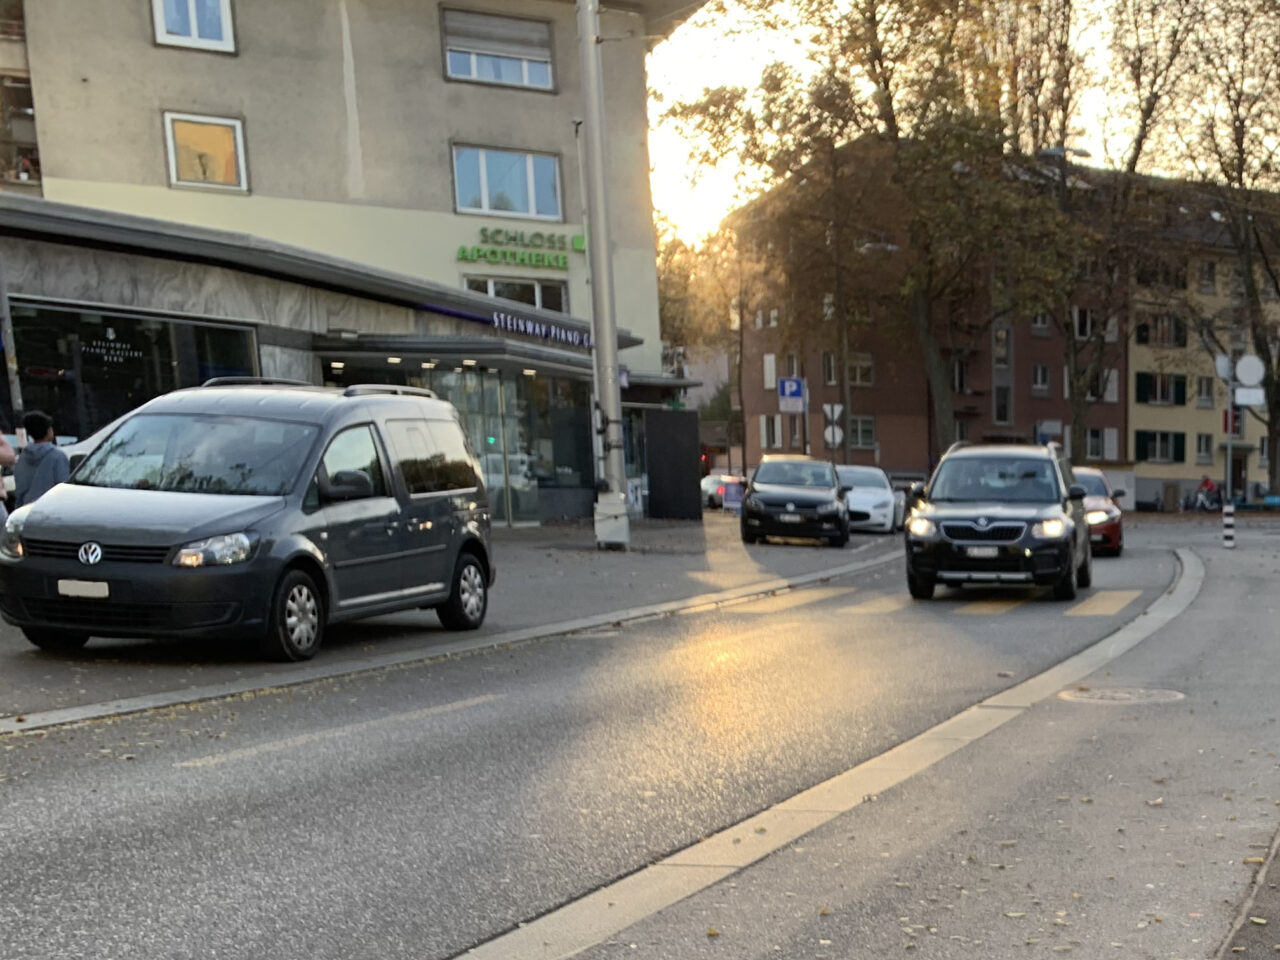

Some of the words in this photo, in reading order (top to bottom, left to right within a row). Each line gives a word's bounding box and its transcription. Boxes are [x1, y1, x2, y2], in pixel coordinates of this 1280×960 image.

[479, 227, 567, 251] SCHLOSS
[457, 245, 569, 270] APOTHEKE
[493, 312, 546, 338] STEINWAY
[550, 325, 580, 346] PIANO
[80, 346, 107, 355] PIANO
[92, 340, 131, 350] STEINWAY
[784, 380, 798, 396] P
